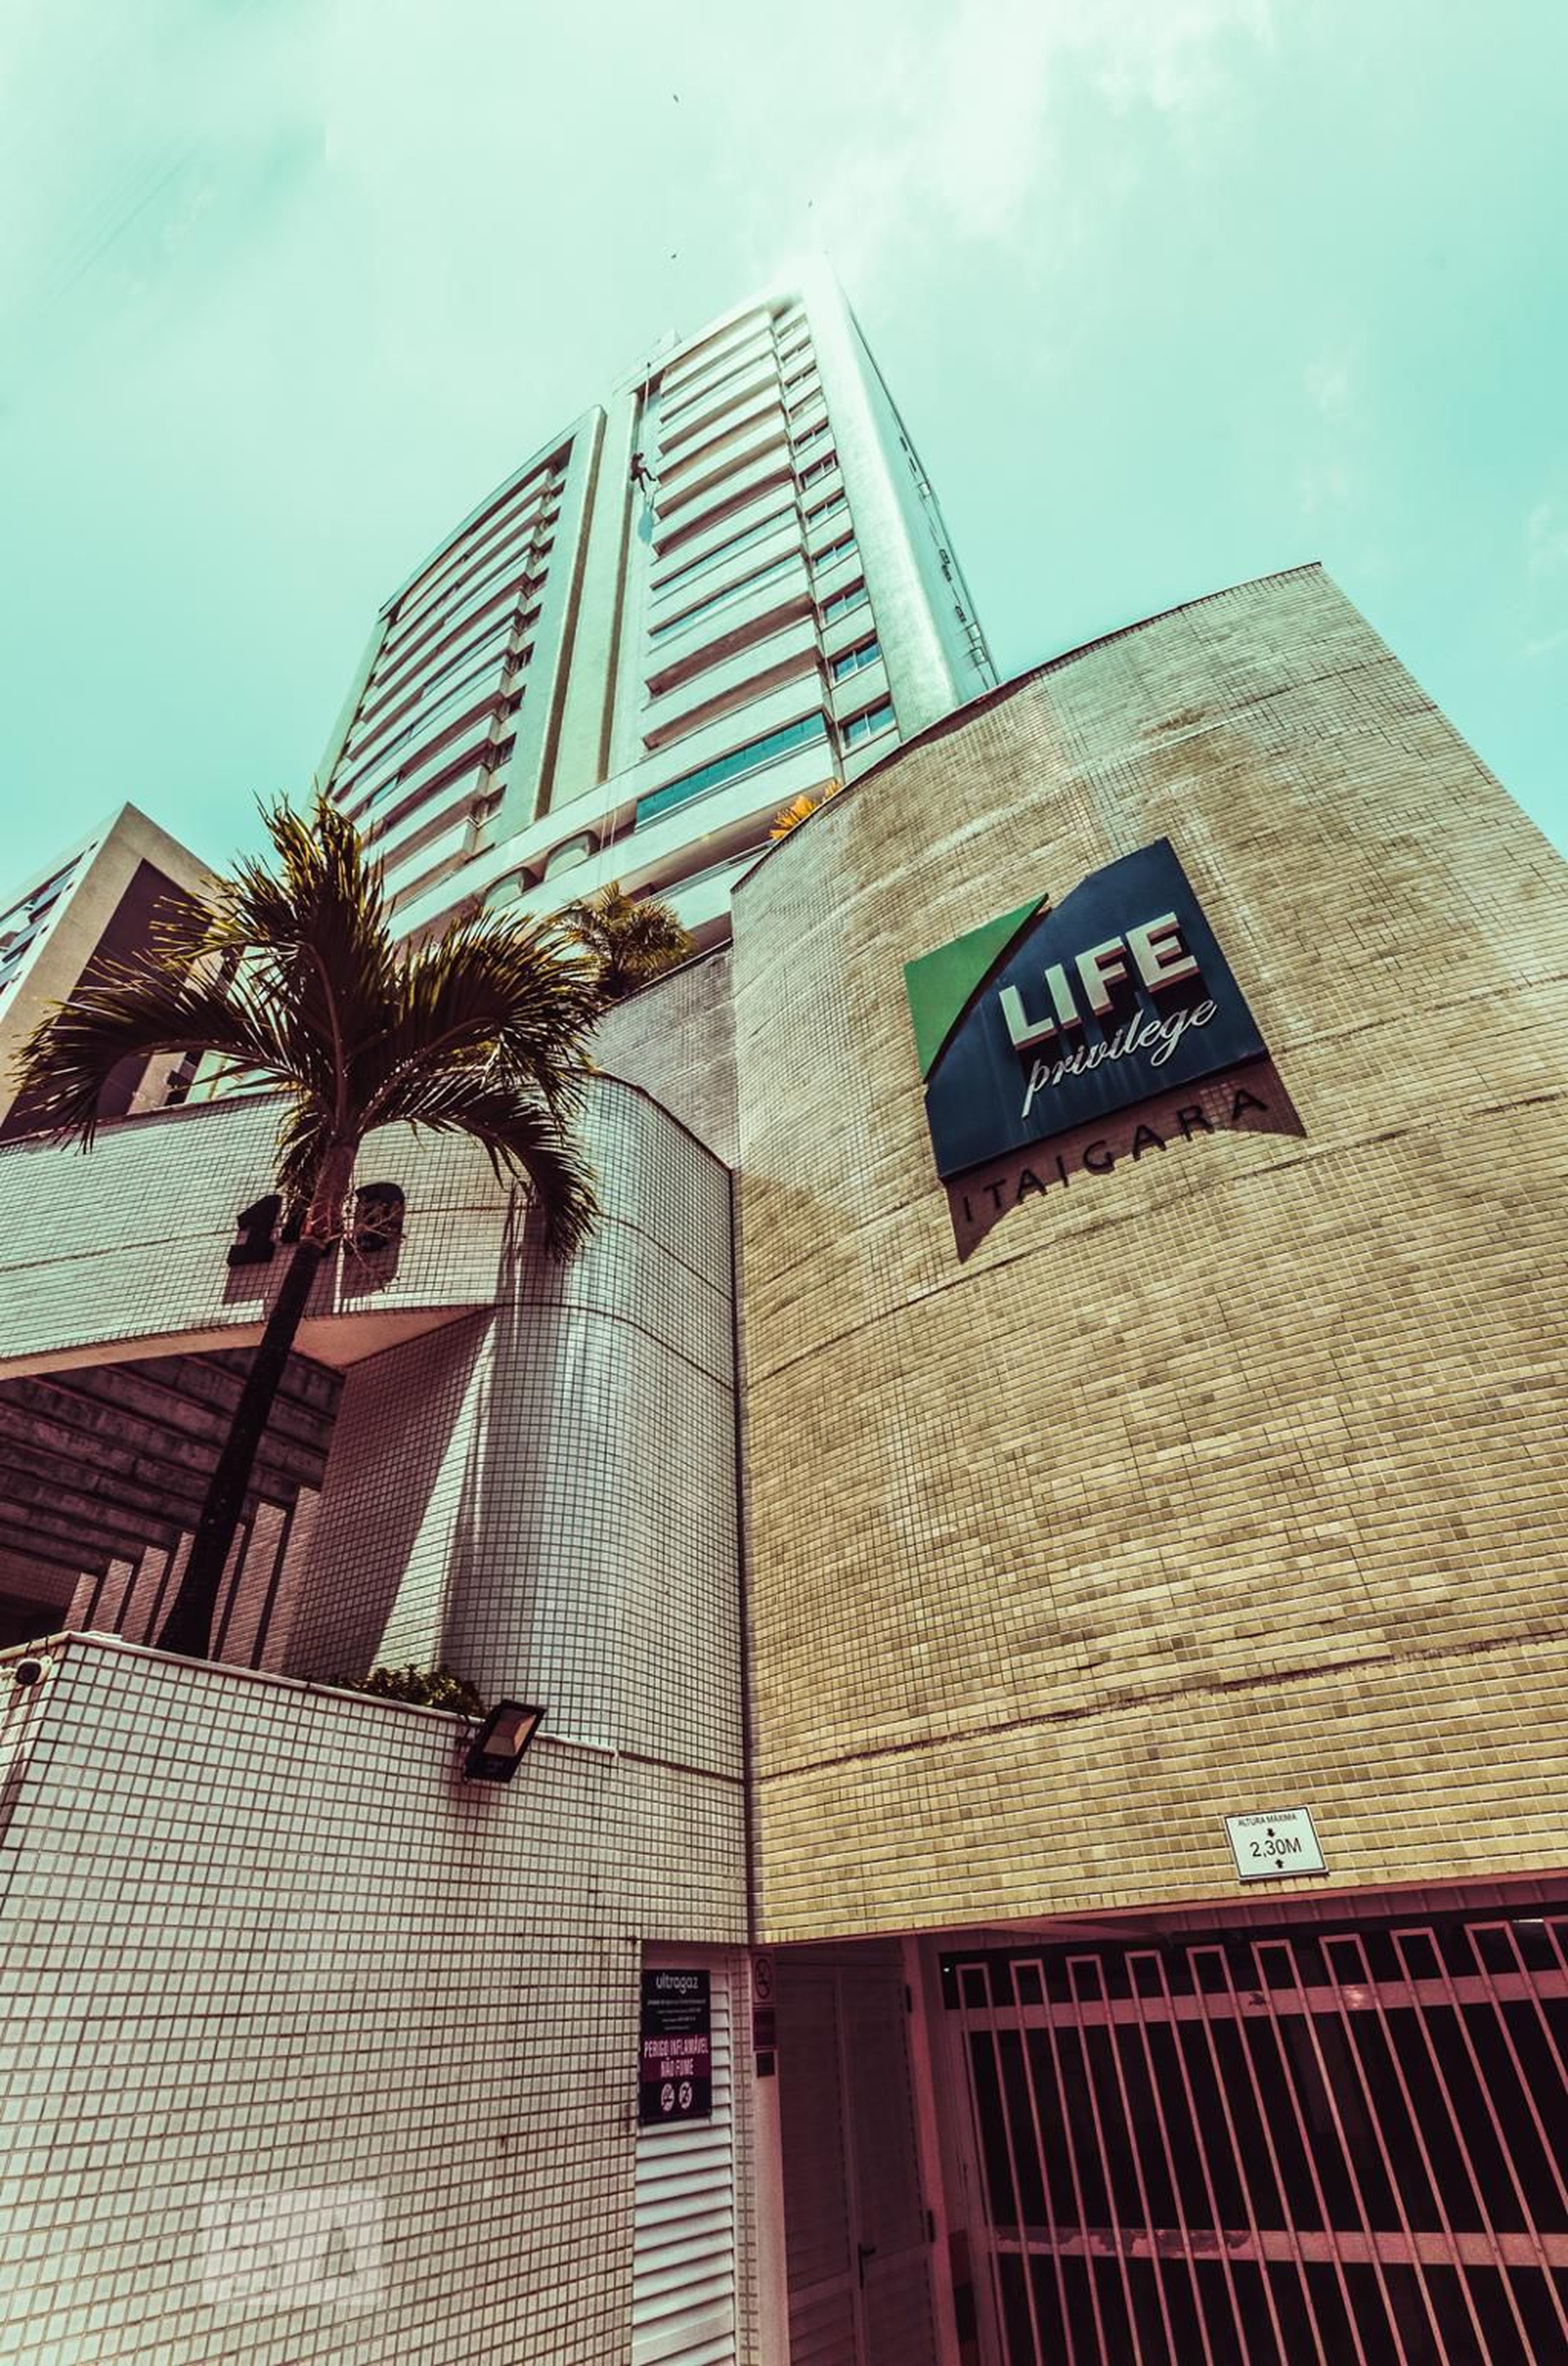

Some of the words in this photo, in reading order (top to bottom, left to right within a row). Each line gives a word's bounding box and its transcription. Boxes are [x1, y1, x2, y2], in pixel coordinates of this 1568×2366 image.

[998, 911, 1200, 1050] LIFE
[1021, 1000, 1217, 1118] privilege
[962, 1089, 1268, 1222] ITAIGARA
[1238, 1817, 1265, 1826] ALTURA
[656, 1972, 699, 1994] ultragaz
[644, 2040, 669, 2058] PERIGO
[670, 2035, 708, 2056] INFLAMÁVEL
[661, 2057, 674, 2077] NÃO
[675, 2058, 693, 2076] FUME
